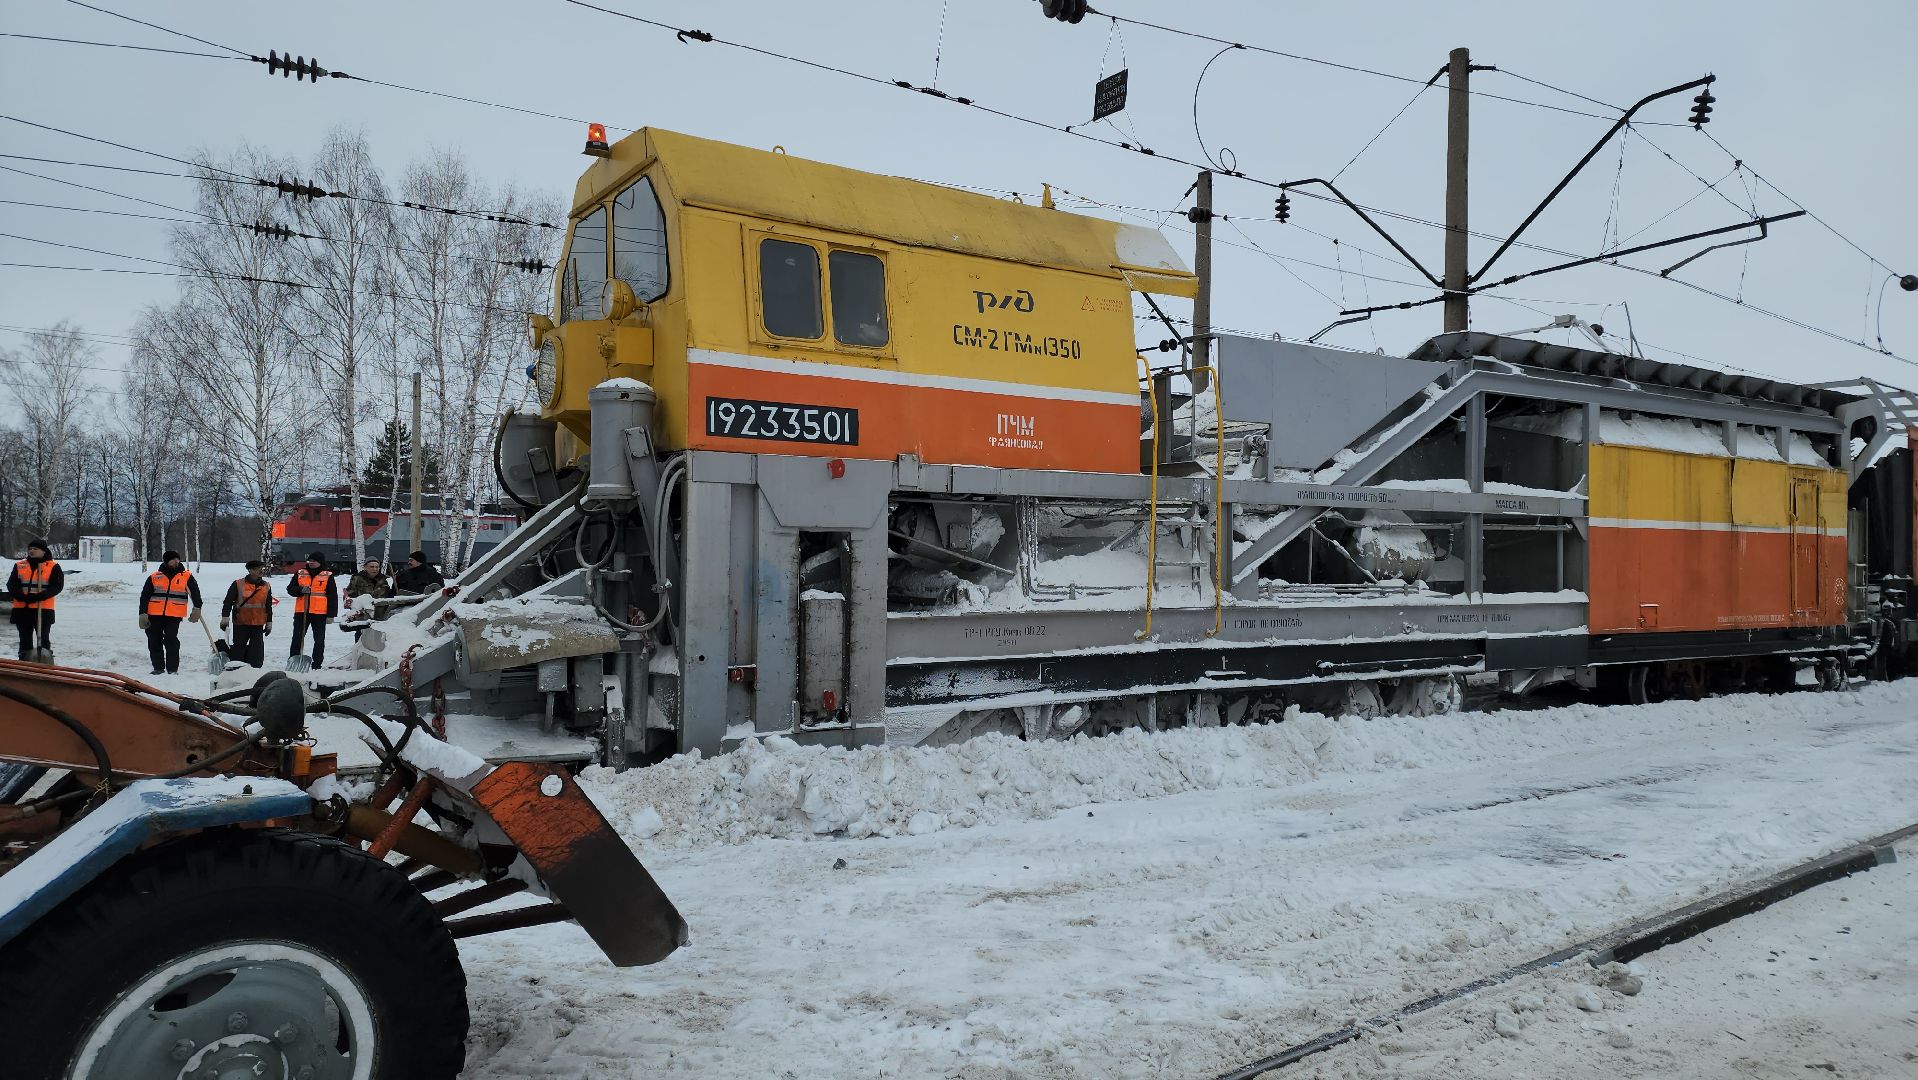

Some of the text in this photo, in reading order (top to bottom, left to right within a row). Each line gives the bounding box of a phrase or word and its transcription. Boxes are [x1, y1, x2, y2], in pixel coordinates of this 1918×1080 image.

[710, 400, 850, 443] 19233501
[997, 413, 1035, 436] ПЧМ
[1495, 499, 1517, 509] МАССА
